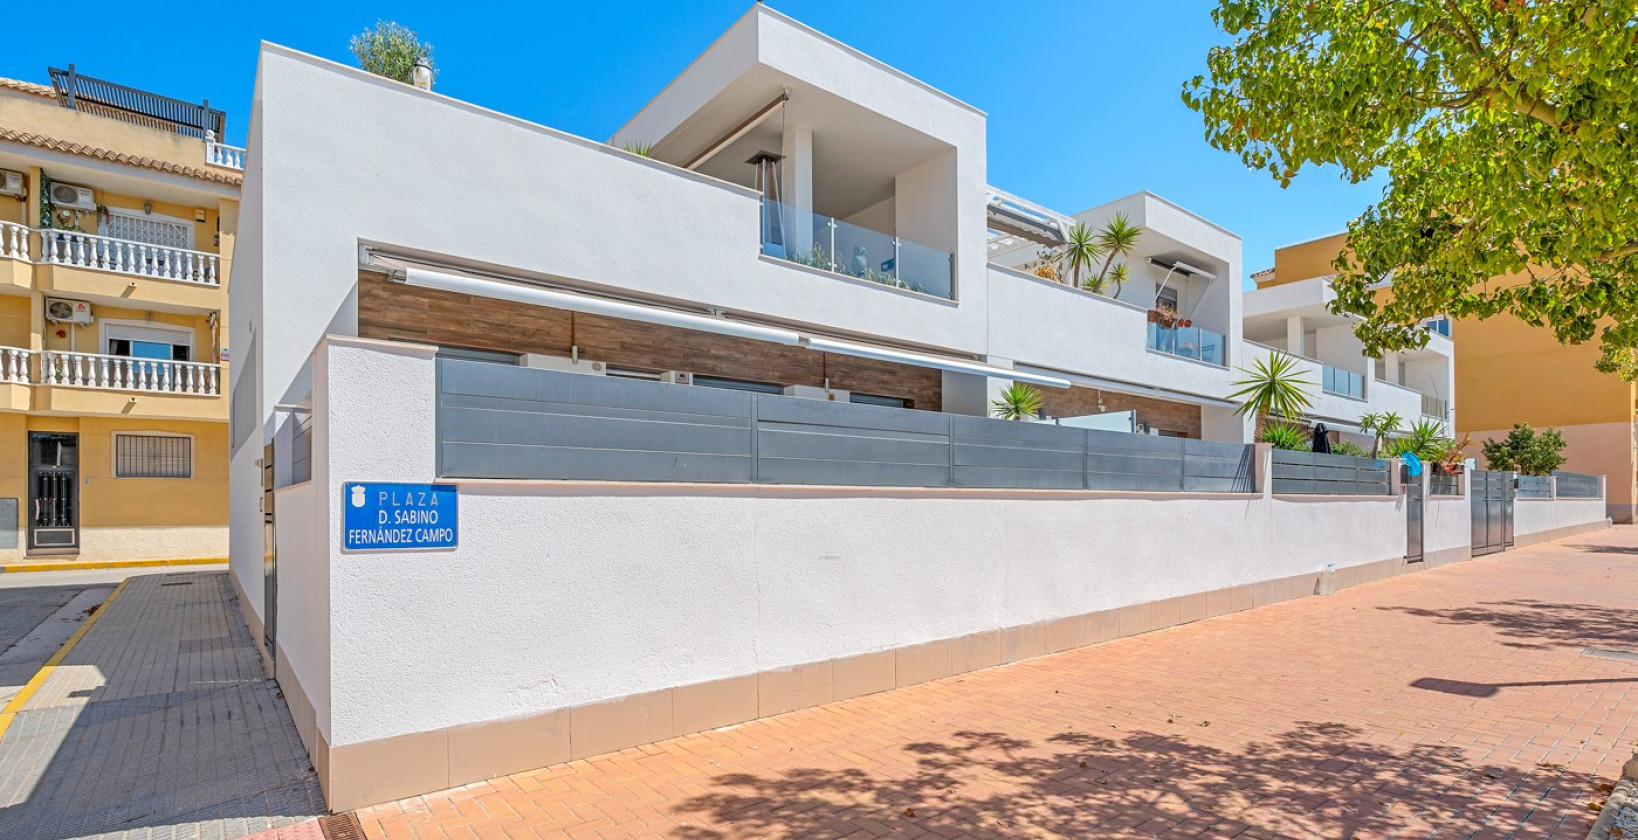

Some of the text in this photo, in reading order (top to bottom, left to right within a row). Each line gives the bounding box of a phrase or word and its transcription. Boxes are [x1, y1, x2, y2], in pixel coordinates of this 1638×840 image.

[379, 491, 439, 507] PLAZA
[378, 510, 439, 525] D. SABINO
[349, 526, 454, 544] FERNÁNDEZ CAMPO
